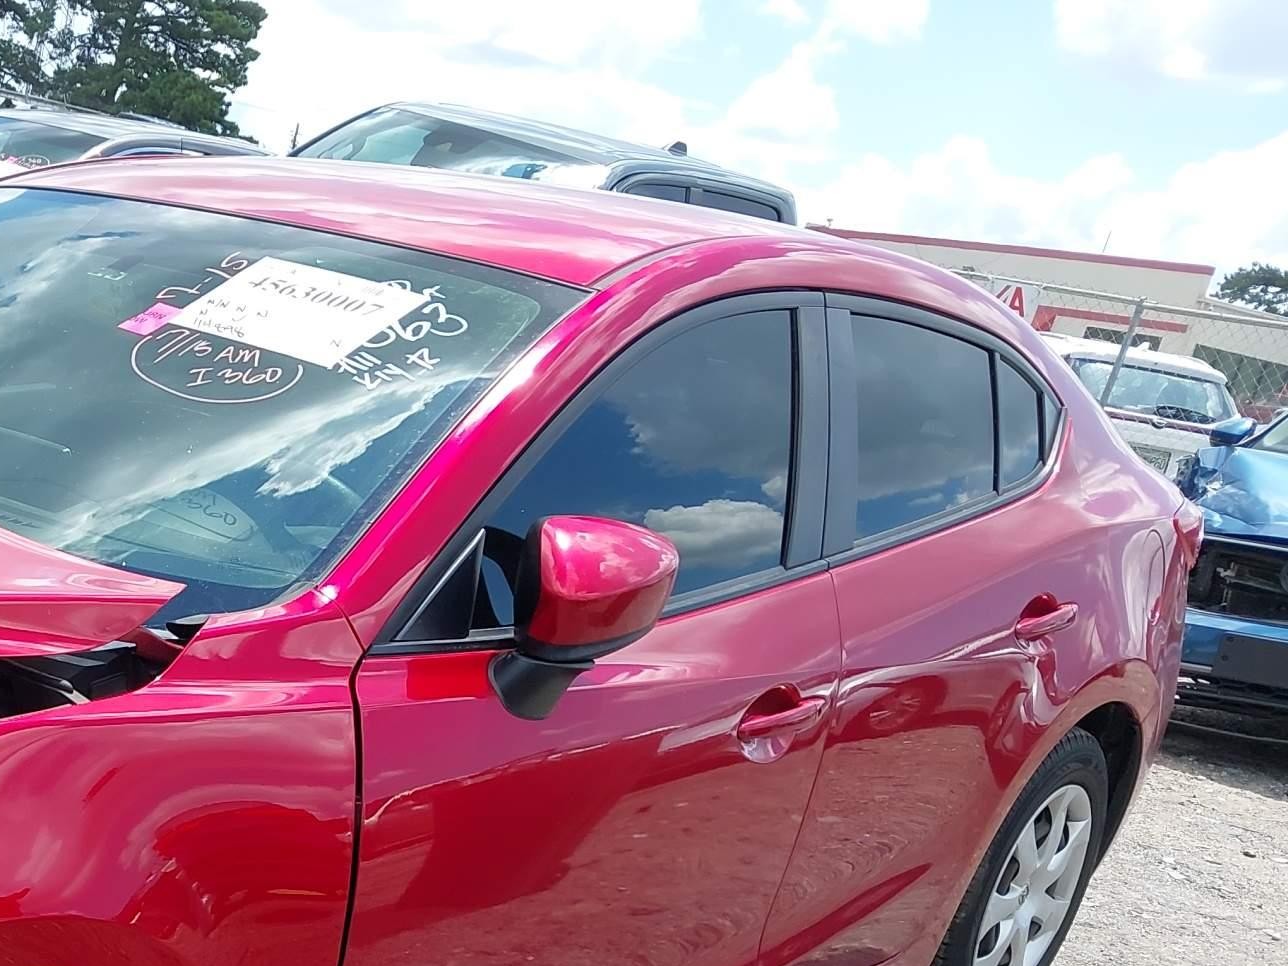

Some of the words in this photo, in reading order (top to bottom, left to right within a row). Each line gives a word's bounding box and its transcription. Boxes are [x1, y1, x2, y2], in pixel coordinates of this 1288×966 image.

[248, 276, 385, 316] 45630007
[213, 346, 261, 367] AM
[216, 367, 282, 385] 360
